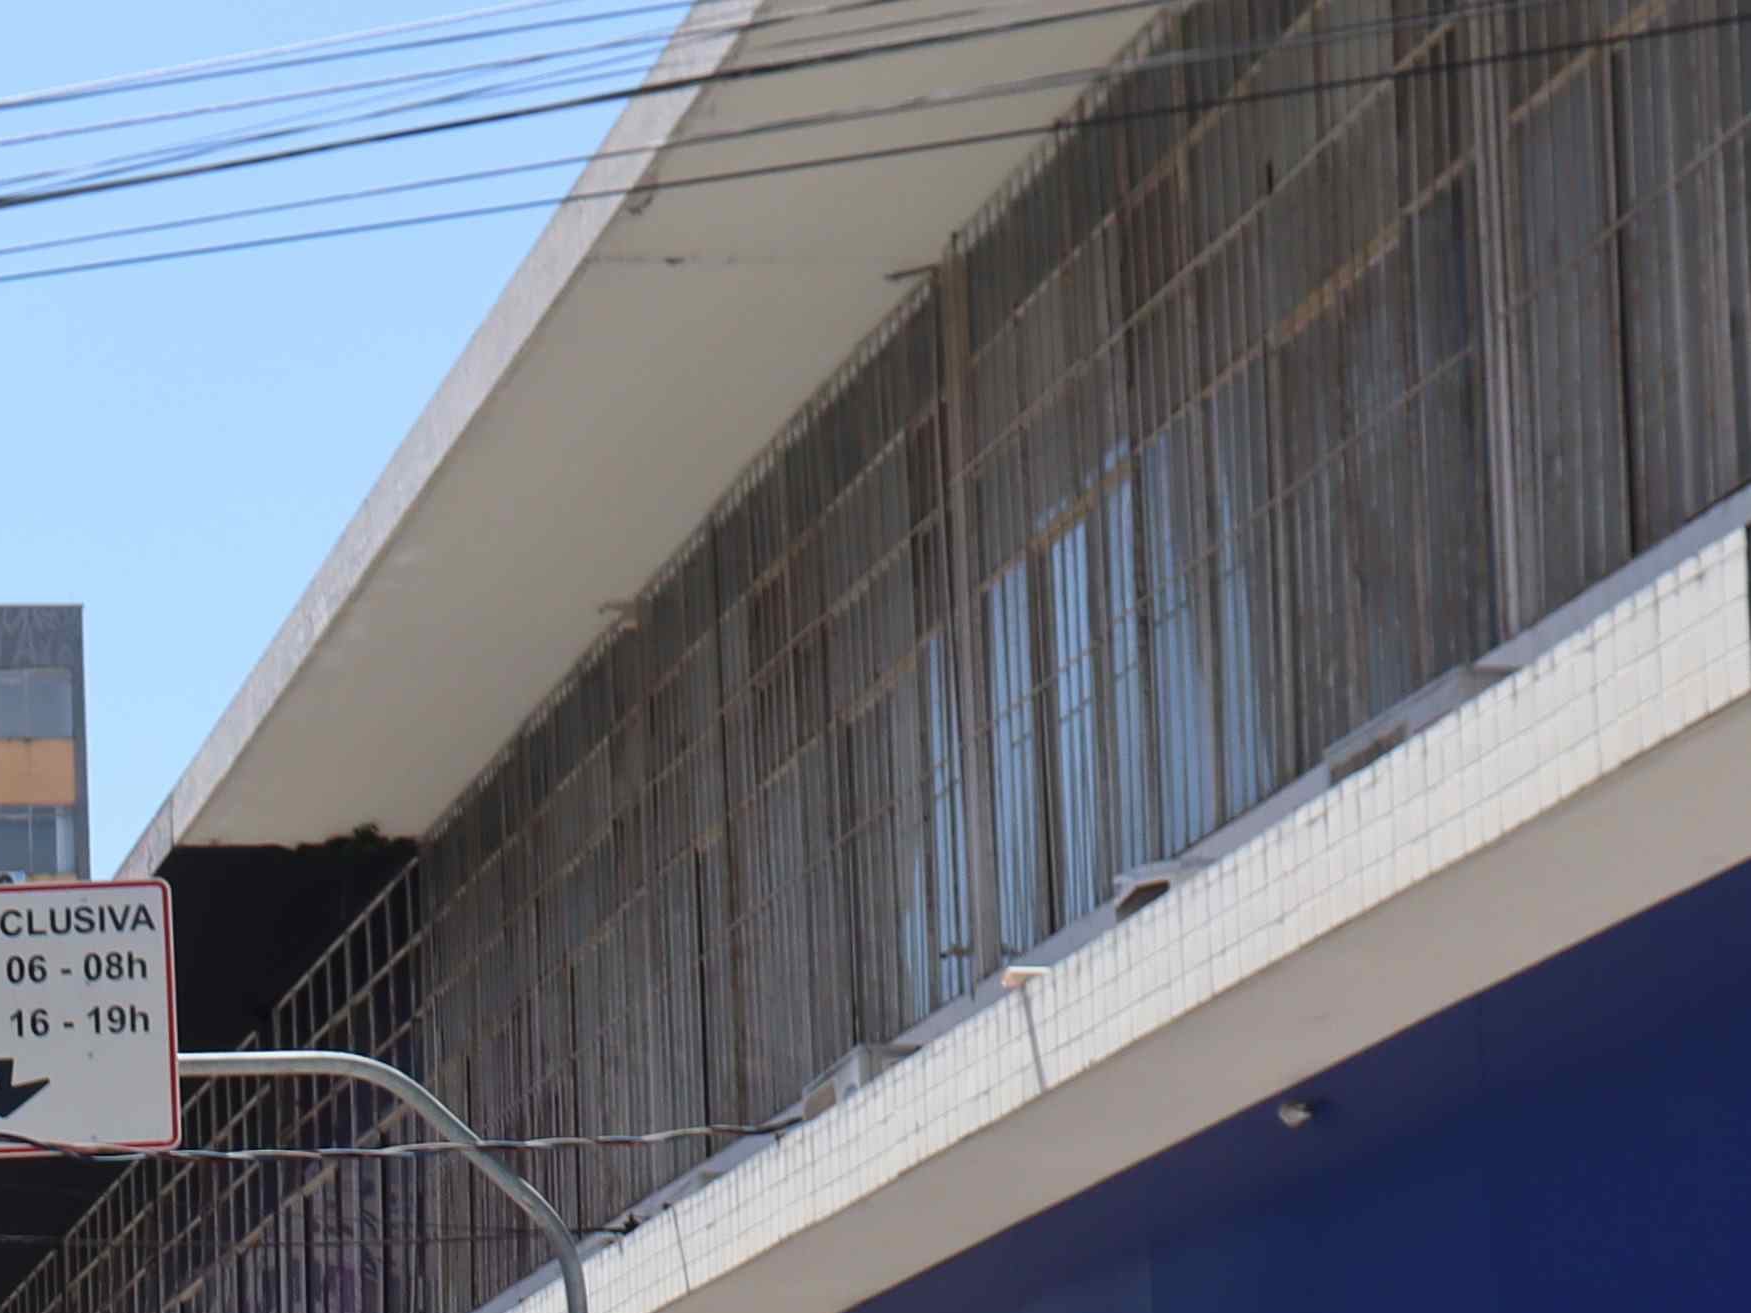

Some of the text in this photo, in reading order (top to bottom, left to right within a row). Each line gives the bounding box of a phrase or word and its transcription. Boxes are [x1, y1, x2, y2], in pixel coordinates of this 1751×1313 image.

[6, 955, 47, 984] 06
[83, 951, 147, 982] 08h
[10, 1008, 50, 1037] 16
[87, 1004, 150, 1035] 19h
